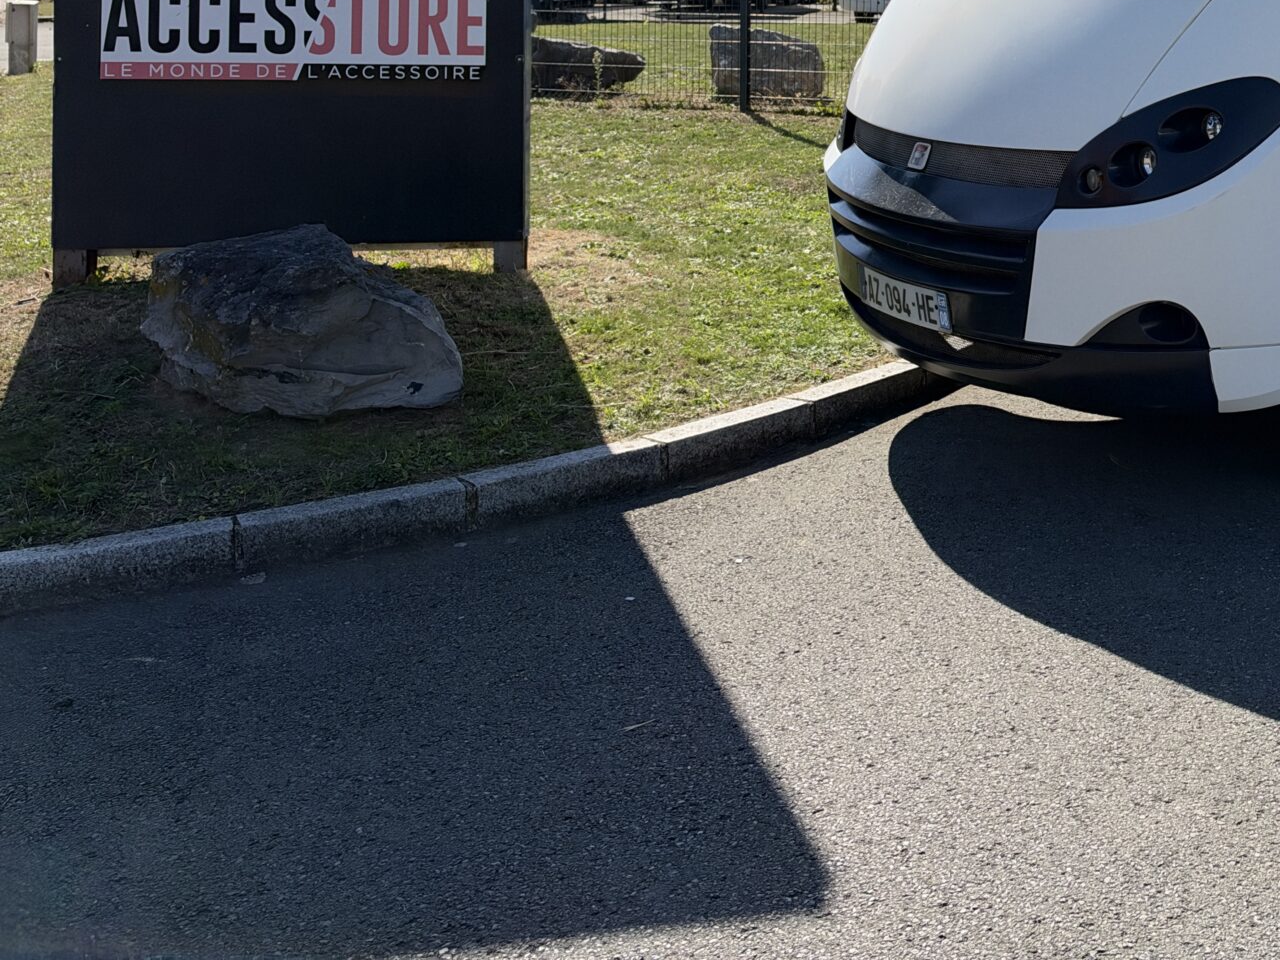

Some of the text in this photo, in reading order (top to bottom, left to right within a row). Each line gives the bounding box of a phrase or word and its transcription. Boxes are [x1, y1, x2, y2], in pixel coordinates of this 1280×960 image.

[105, 63, 481, 80] LE MONDE DE L'ACCESSOIRE
